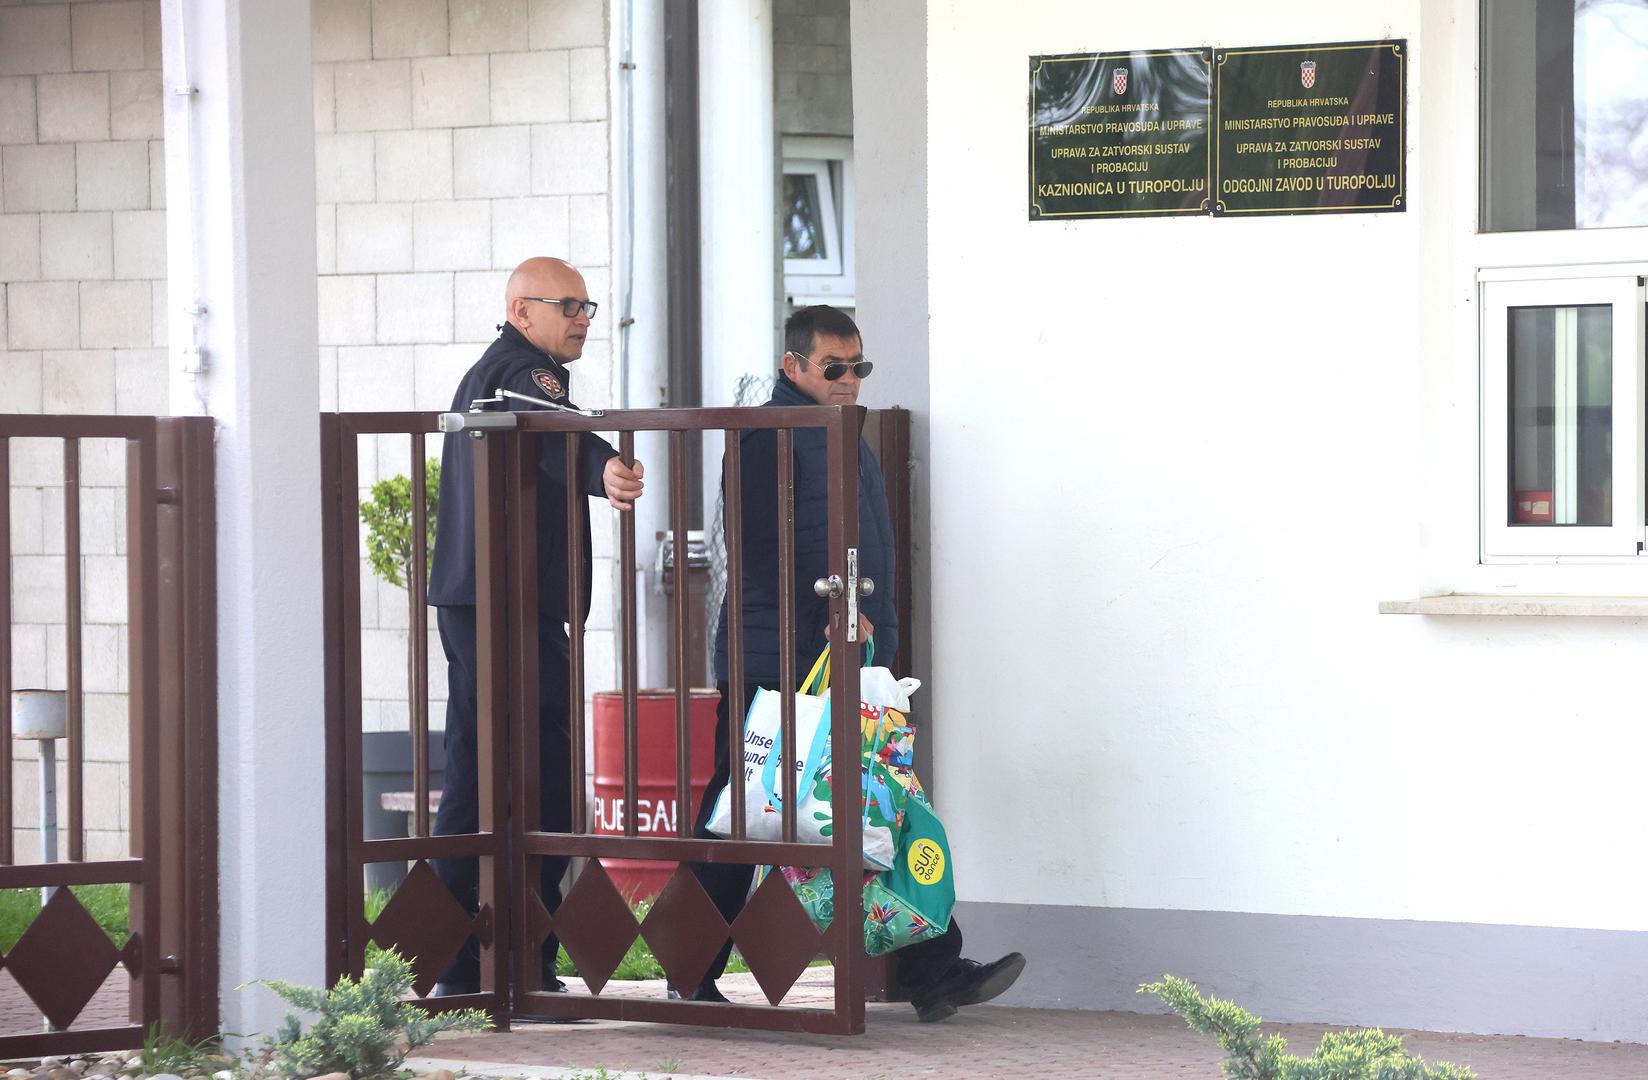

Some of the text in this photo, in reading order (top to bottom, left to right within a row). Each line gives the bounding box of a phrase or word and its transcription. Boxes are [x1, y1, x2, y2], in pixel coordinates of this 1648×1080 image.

[1082, 105, 1120, 113] REPUBLIKA
[1268, 98, 1348, 108] REPUBLIKA HRVATSKA
[1040, 124, 1103, 136] MINISTARSTVO
[1106, 121, 1159, 132] PRAVOSUĐA
[1168, 119, 1202, 130] UPRAVE
[1225, 118, 1290, 130] MINISTARSTVO
[1293, 115, 1349, 127] PRAVOSUĐA
[1357, 114, 1393, 125] UPRAVE
[1052, 144, 1190, 159] UPRAVA ZA ZATVORSKI SUSTAV
[1237, 139, 1381, 153] UPRAVA ZA ZATVORSKI SUSTAV
[1097, 162, 1148, 173] PROBACIJU
[1283, 157, 1337, 168] PROBACIJU
[1038, 179, 1204, 197] KAZNIONICA U TUROPOLJU
[1223, 174, 1396, 193] ODGOJNI ZAVOD U TUROPOLJU
[924, 854, 940, 880] dance
